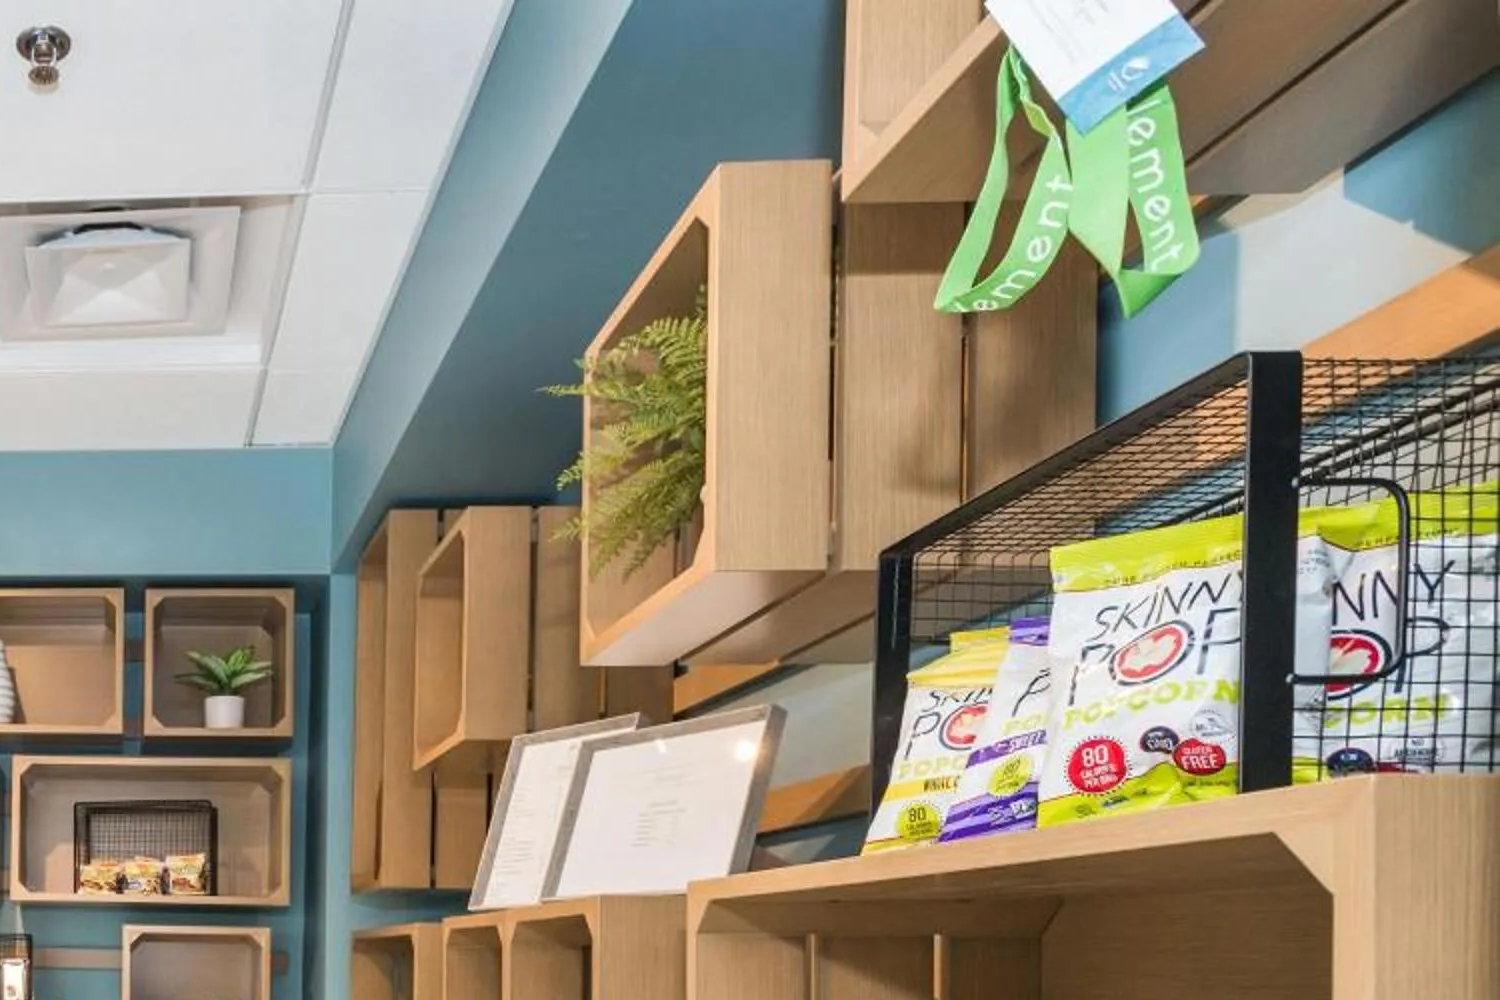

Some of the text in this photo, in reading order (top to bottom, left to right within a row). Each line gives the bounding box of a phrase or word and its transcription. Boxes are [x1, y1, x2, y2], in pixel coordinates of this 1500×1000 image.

[1086, 570, 1243, 643] SKINN
[1081, 744, 1110, 768] 80
[1181, 752, 1222, 771] FREE
